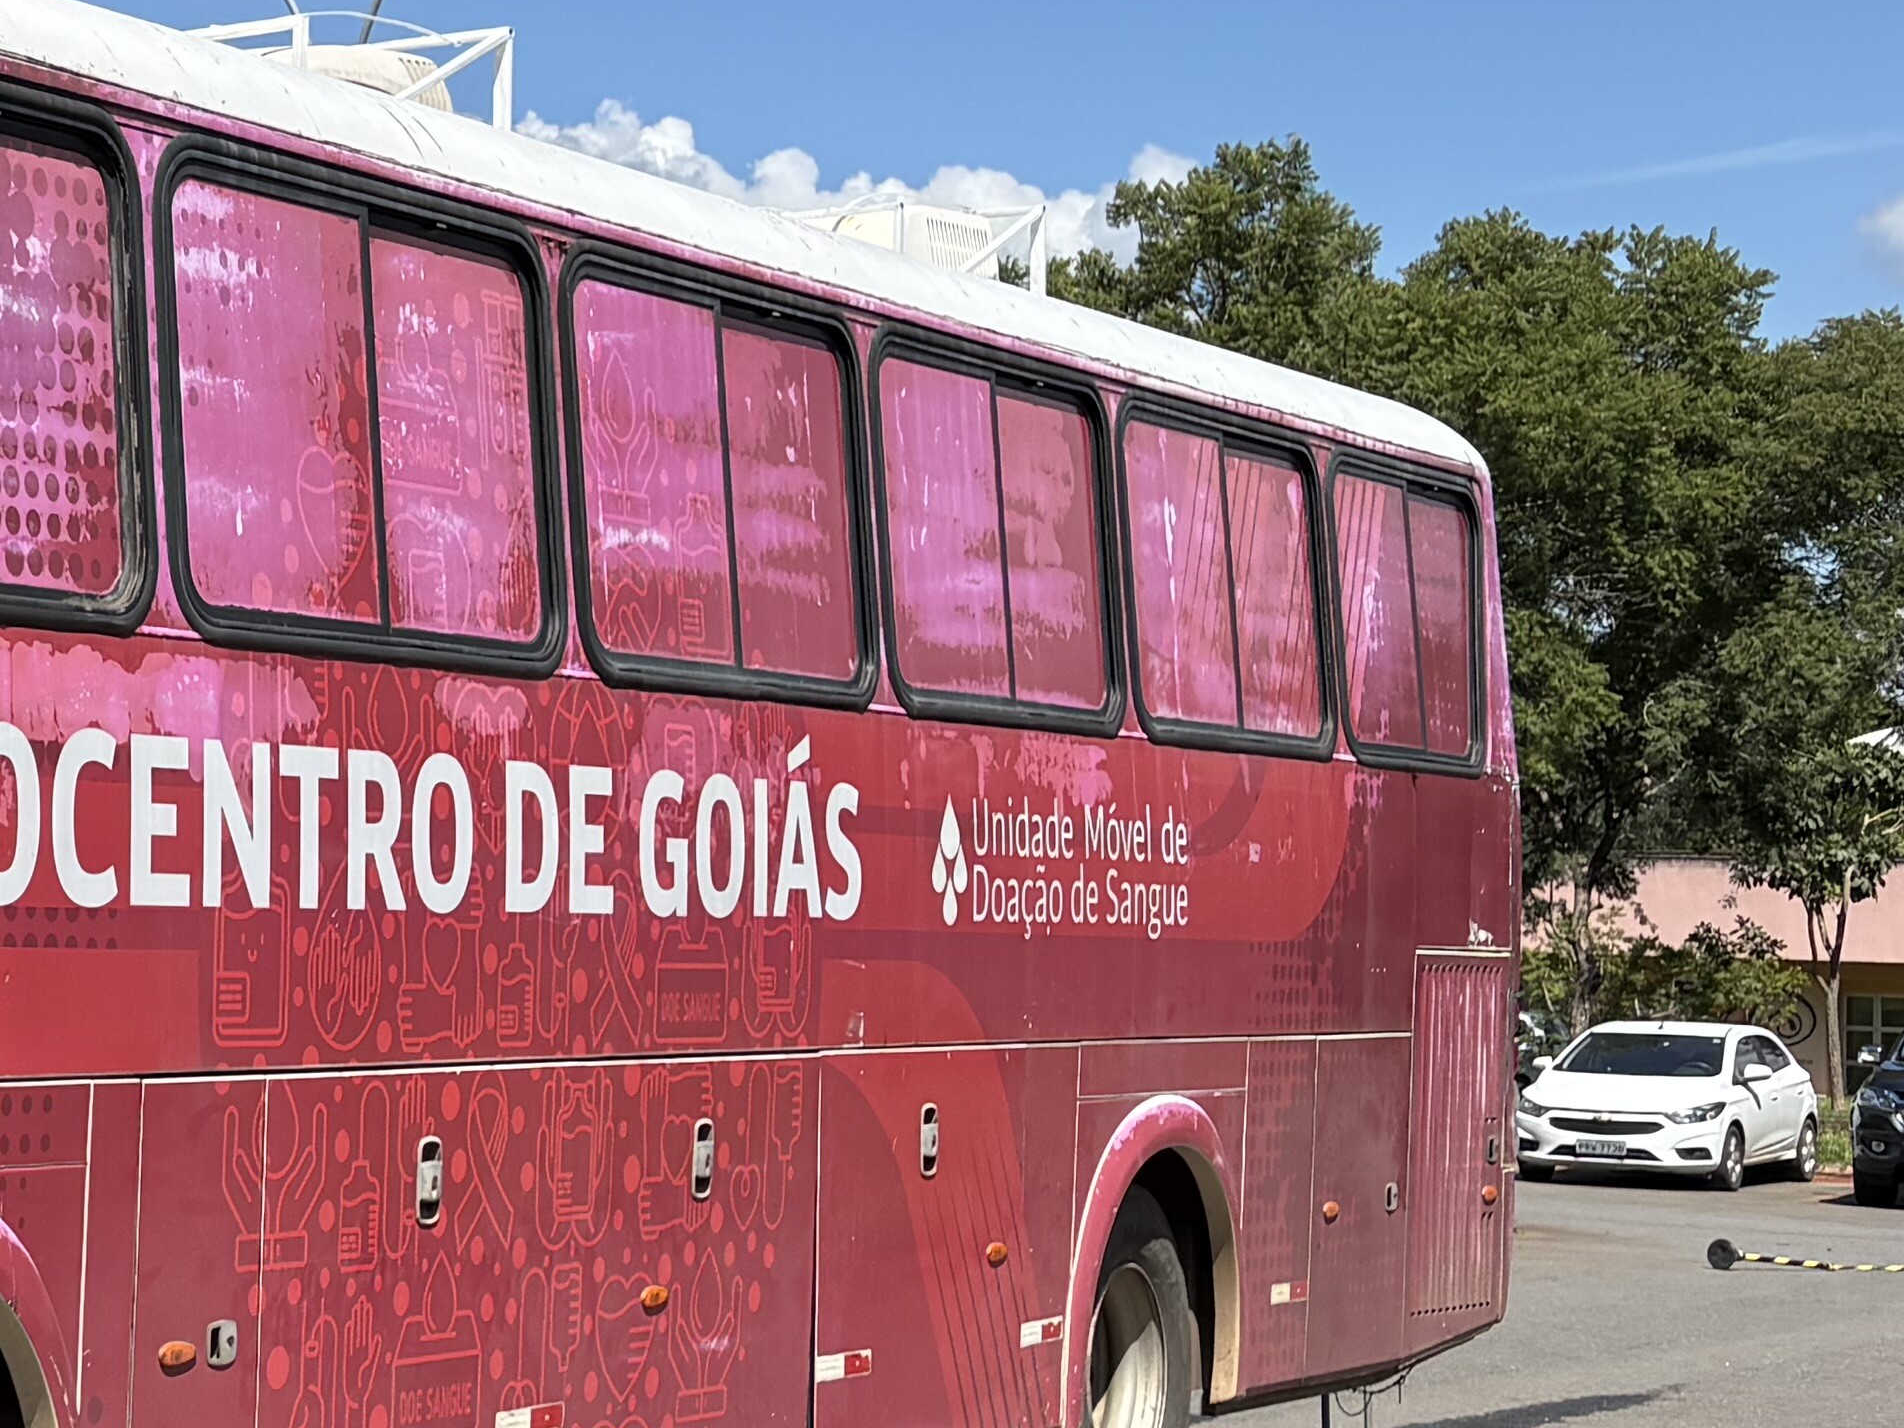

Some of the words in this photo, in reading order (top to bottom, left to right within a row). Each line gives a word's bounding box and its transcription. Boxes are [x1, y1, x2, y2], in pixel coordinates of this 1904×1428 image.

[504, 759, 615, 915] DE
[638, 734, 863, 921] GOIÁS
[972, 795, 1074, 859] Unidade
[1084, 802, 1152, 862] Móvel
[1161, 805, 1188, 865] de
[972, 863, 1064, 940] Doação
[1071, 862, 1099, 924] de
[1106, 867, 1189, 940] Sangue
[400, 1387, 423, 1425] DOE
[426, 1381, 472, 1420] SANGUE
